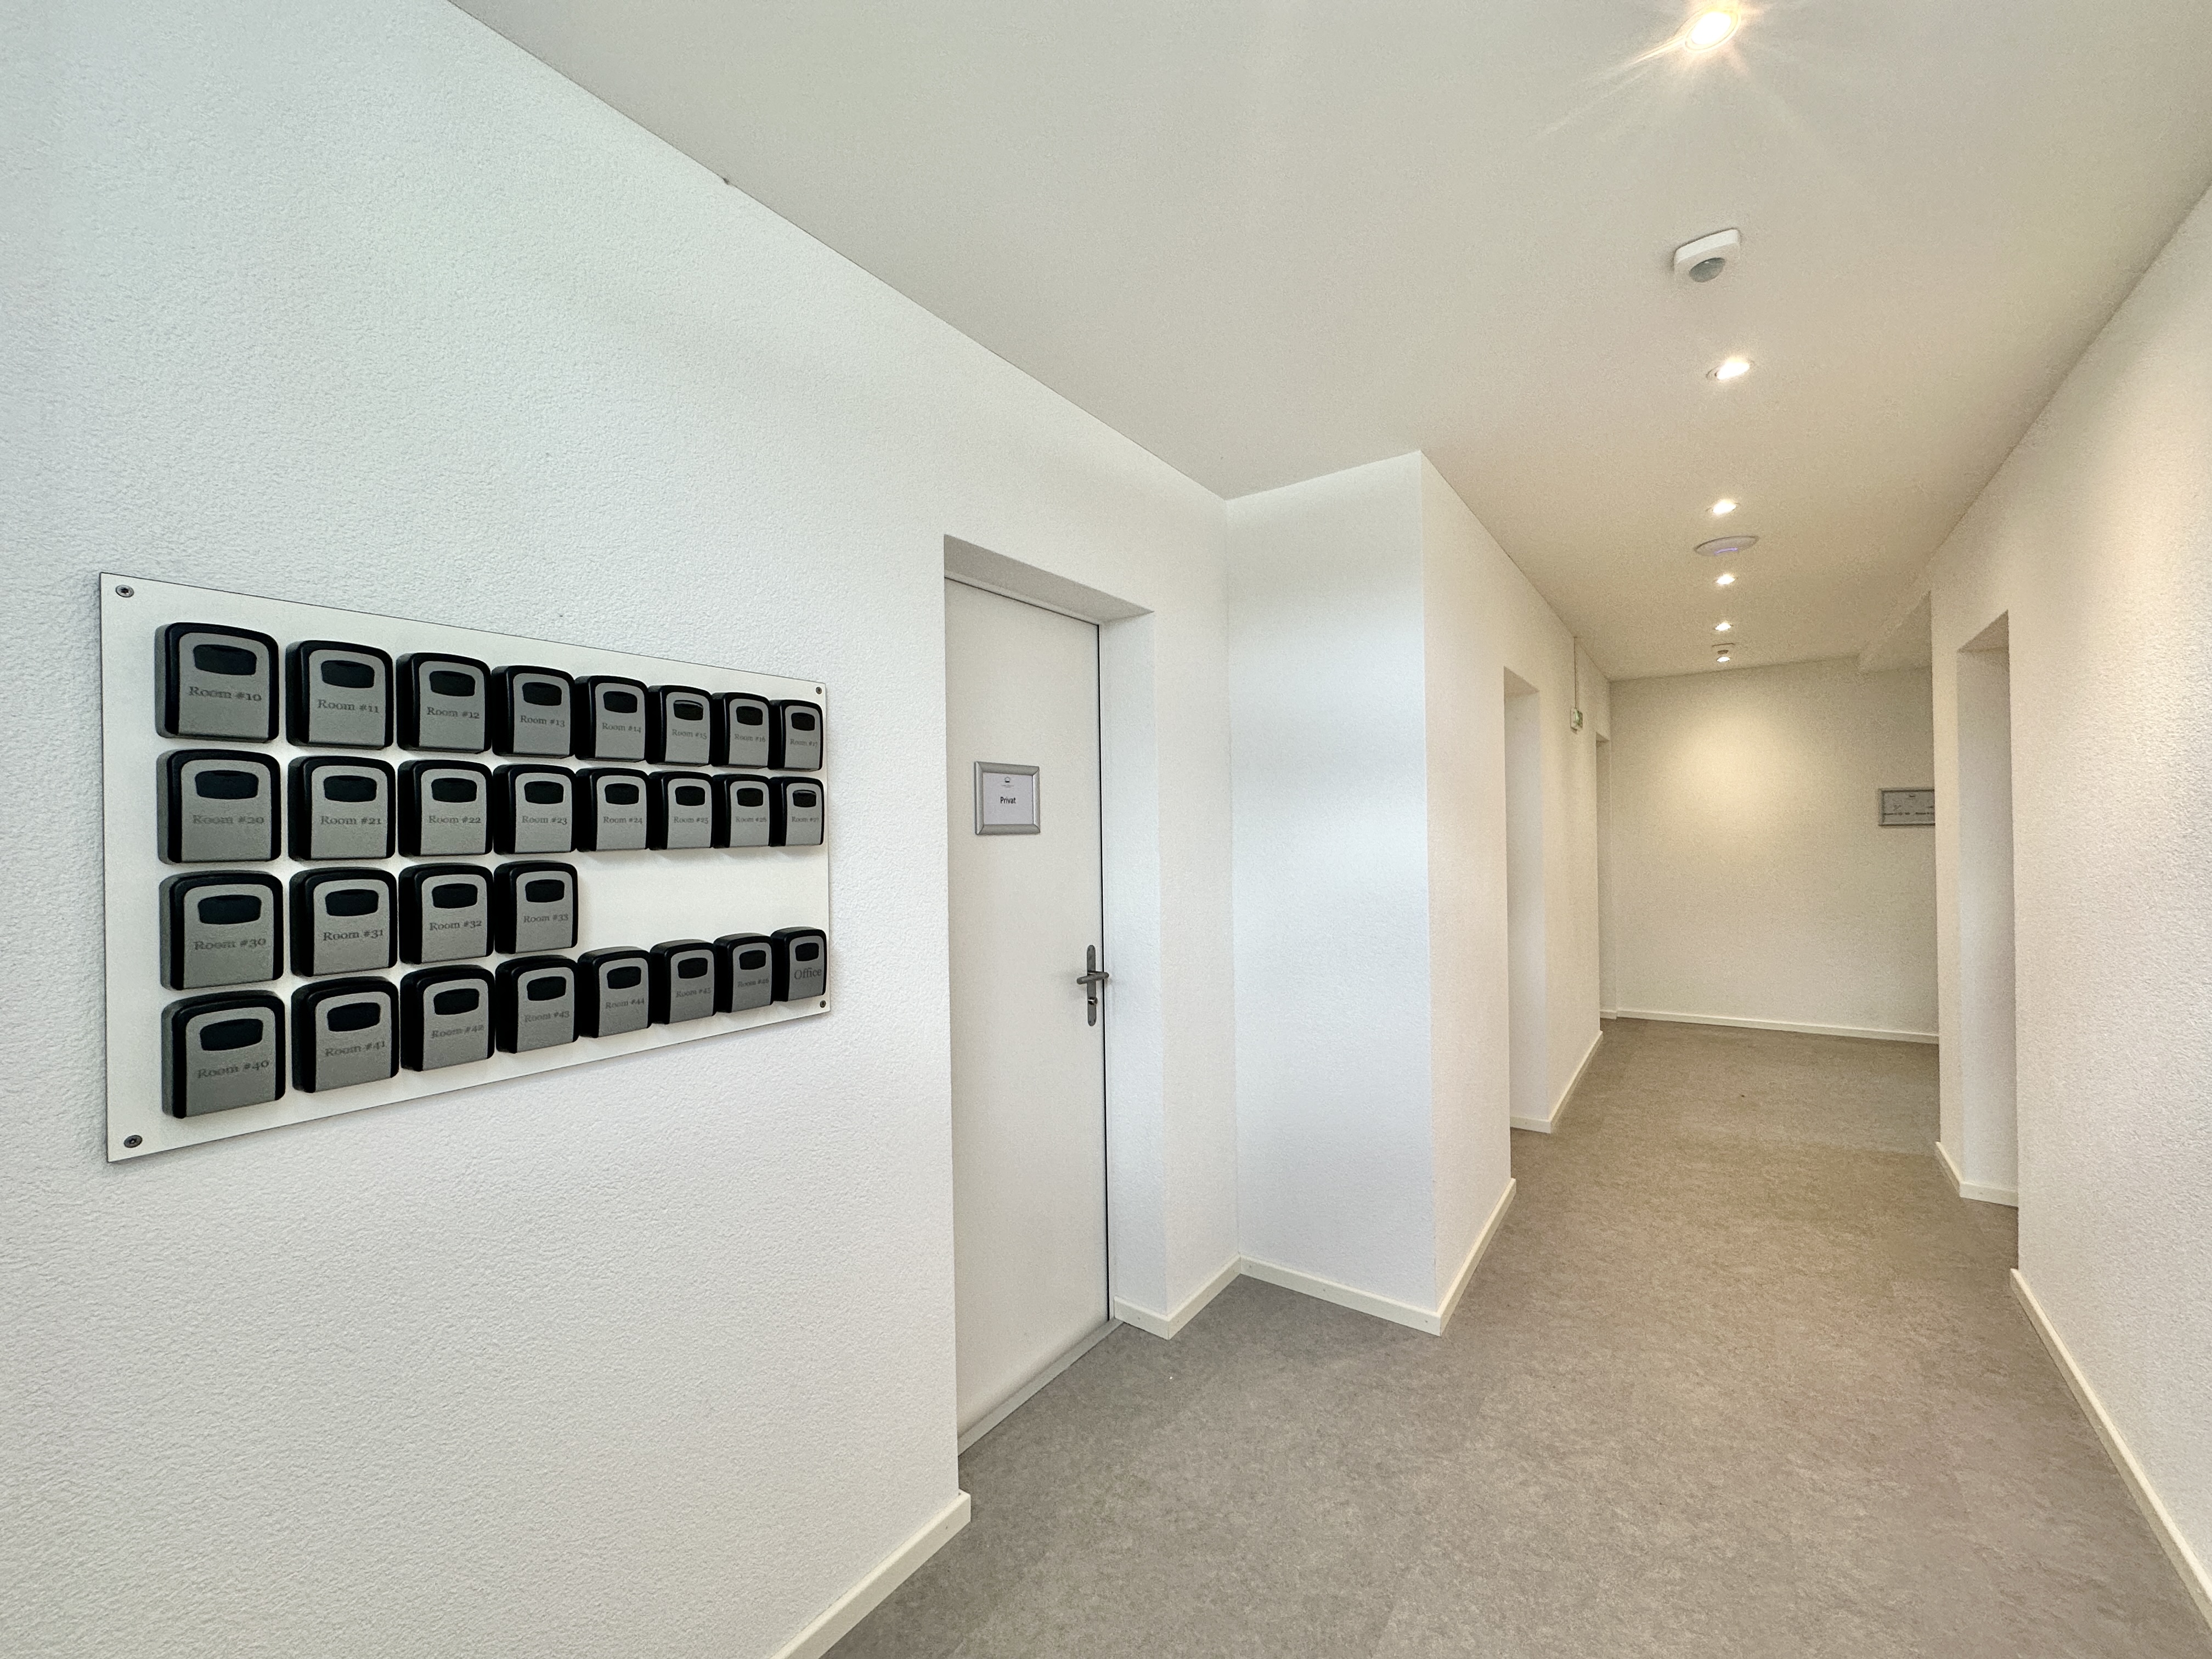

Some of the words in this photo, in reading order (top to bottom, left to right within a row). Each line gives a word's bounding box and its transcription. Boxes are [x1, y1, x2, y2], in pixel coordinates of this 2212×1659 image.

[189, 686, 232, 700] Room
[236, 693, 262, 702] #10
[318, 699, 356, 712] Room
[359, 706, 380, 714] #11
[427, 707, 458, 717] Room
[520, 715, 548, 725] Room
[550, 719, 565, 727] #13
[602, 723, 625, 732] Room
[628, 725, 641, 733] #14
[672, 729, 693, 738] Room
[695, 731, 707, 740] #15
[734, 733, 753, 742] Room
[790, 738, 808, 747] Room
[193, 815, 233, 825] Room
[320, 816, 357, 825] Room
[360, 817, 382, 825] #21
[428, 815, 459, 823] Room
[552, 816, 568, 825] #23
[628, 816, 643, 825] #24
[523, 915, 549, 923] Room
[552, 913, 568, 921] #33
[430, 921, 460, 930] Room
[323, 930, 360, 941] Room
[363, 929, 384, 939] #31
[194, 940, 236, 951] Room
[240, 938, 266, 947] #30
[794, 967, 822, 980] Office
[737, 979, 754, 988] Room
[676, 990, 696, 998] Room
[606, 1000, 629, 1009] Room
[631, 997, 645, 1006] #44
[524, 1013, 551, 1023] Room
[553, 1011, 569, 1019] #43
[431, 1028, 462, 1039] Room
[465, 1025, 484, 1034] #42
[325, 1044, 362, 1057] Room
[365, 1041, 385, 1052] #41
[198, 1064, 239, 1079] Room
[243, 1060, 269, 1071] #40
